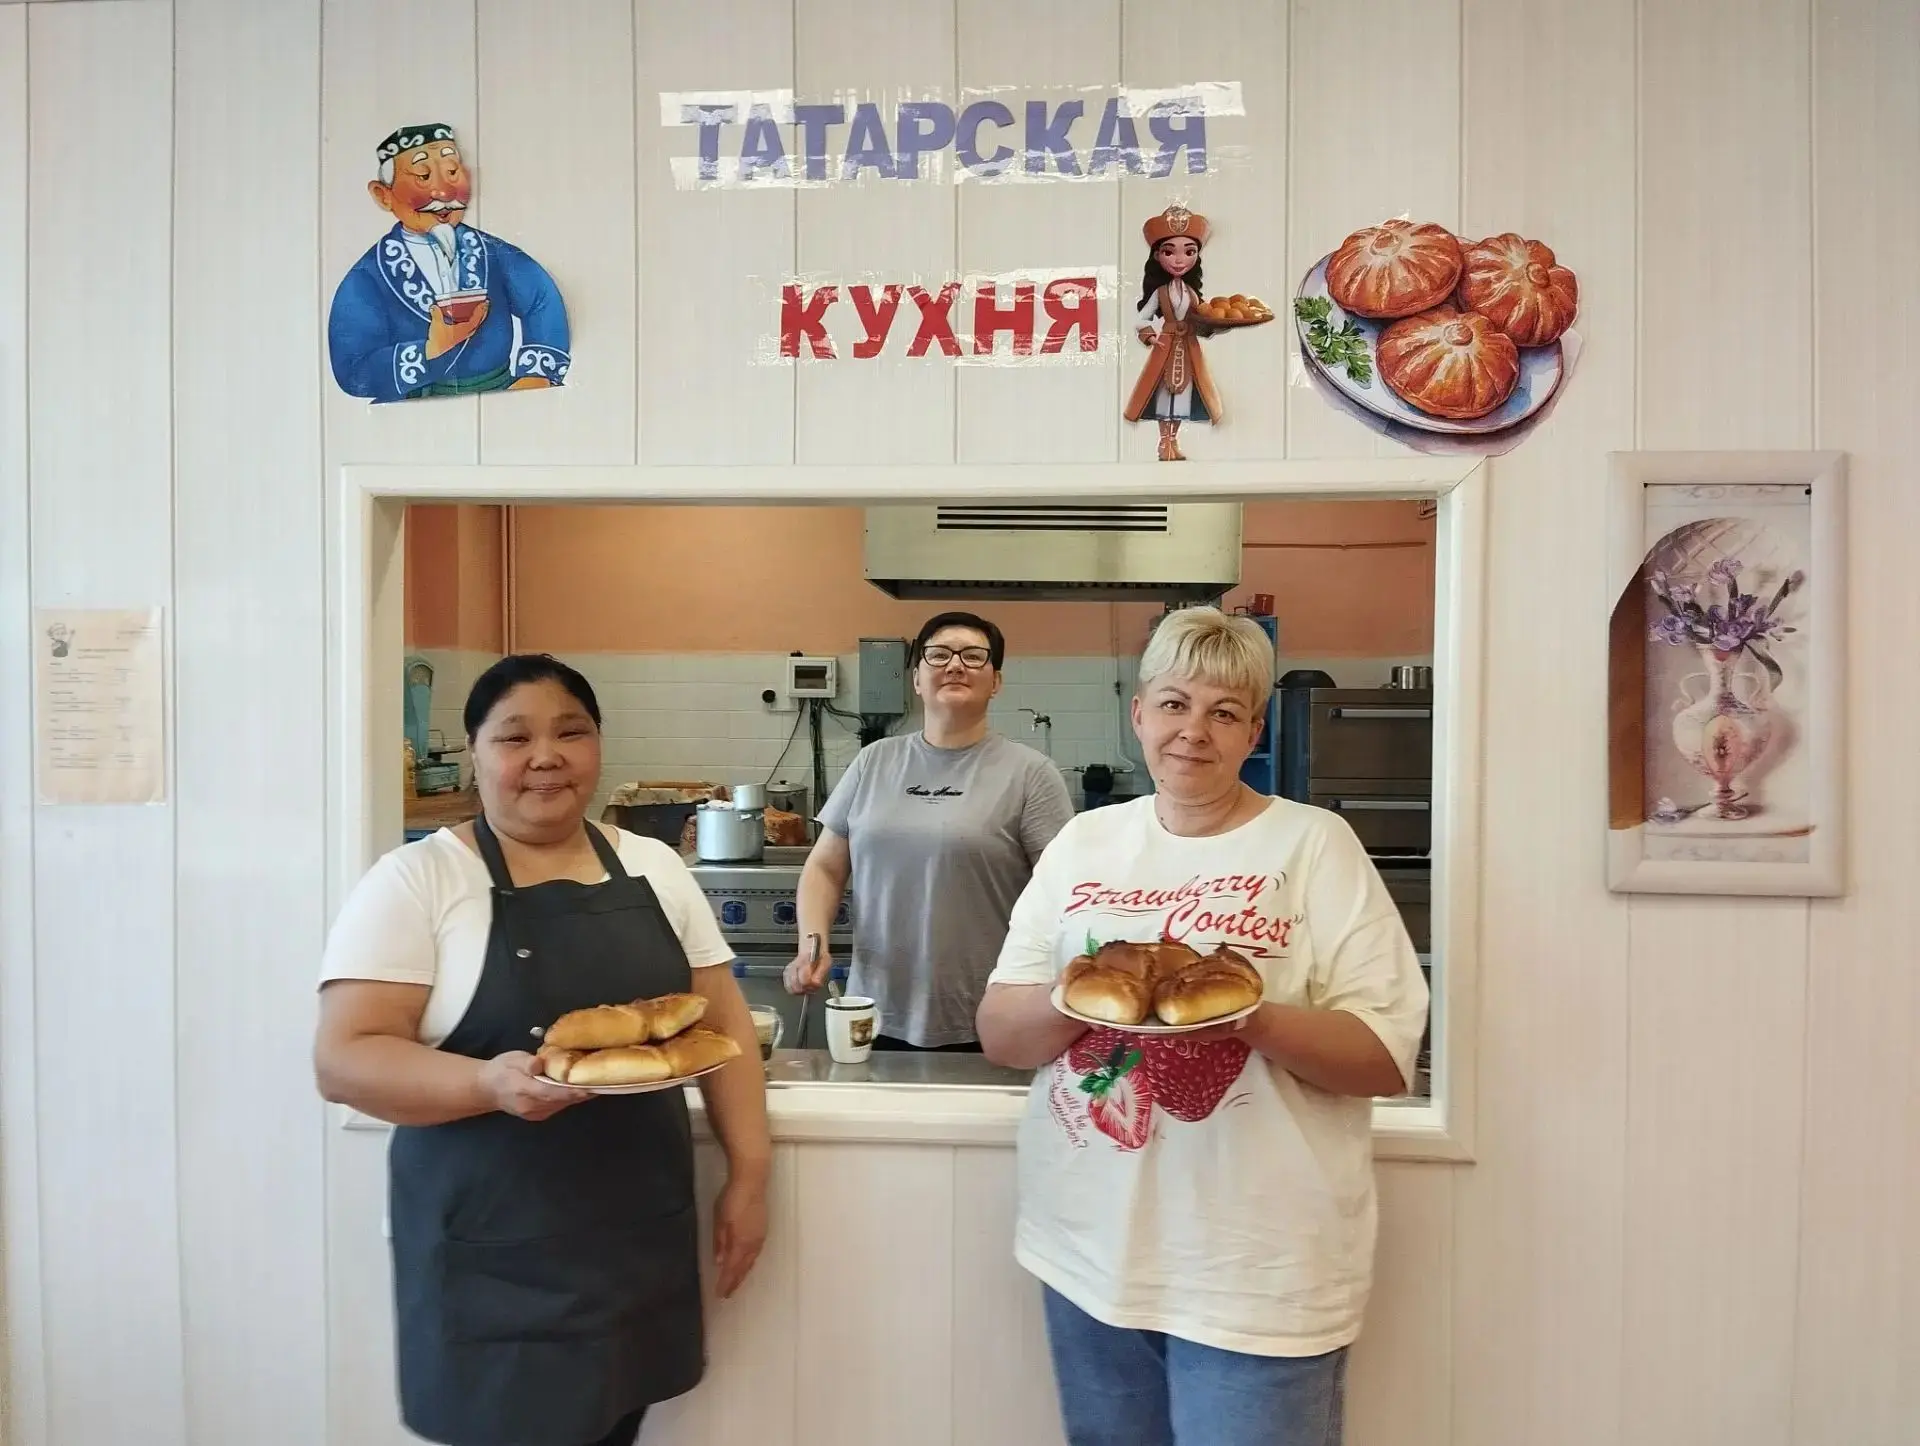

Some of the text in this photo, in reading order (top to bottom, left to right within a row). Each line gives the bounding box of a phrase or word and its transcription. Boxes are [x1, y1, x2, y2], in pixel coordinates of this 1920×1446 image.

[681, 96, 1208, 181] ТАТАРСКАЯ
[779, 277, 1099, 360] КУХНЯ
[1064, 872, 1267, 914] Strawberry
[1163, 898, 1293, 948] Contest
